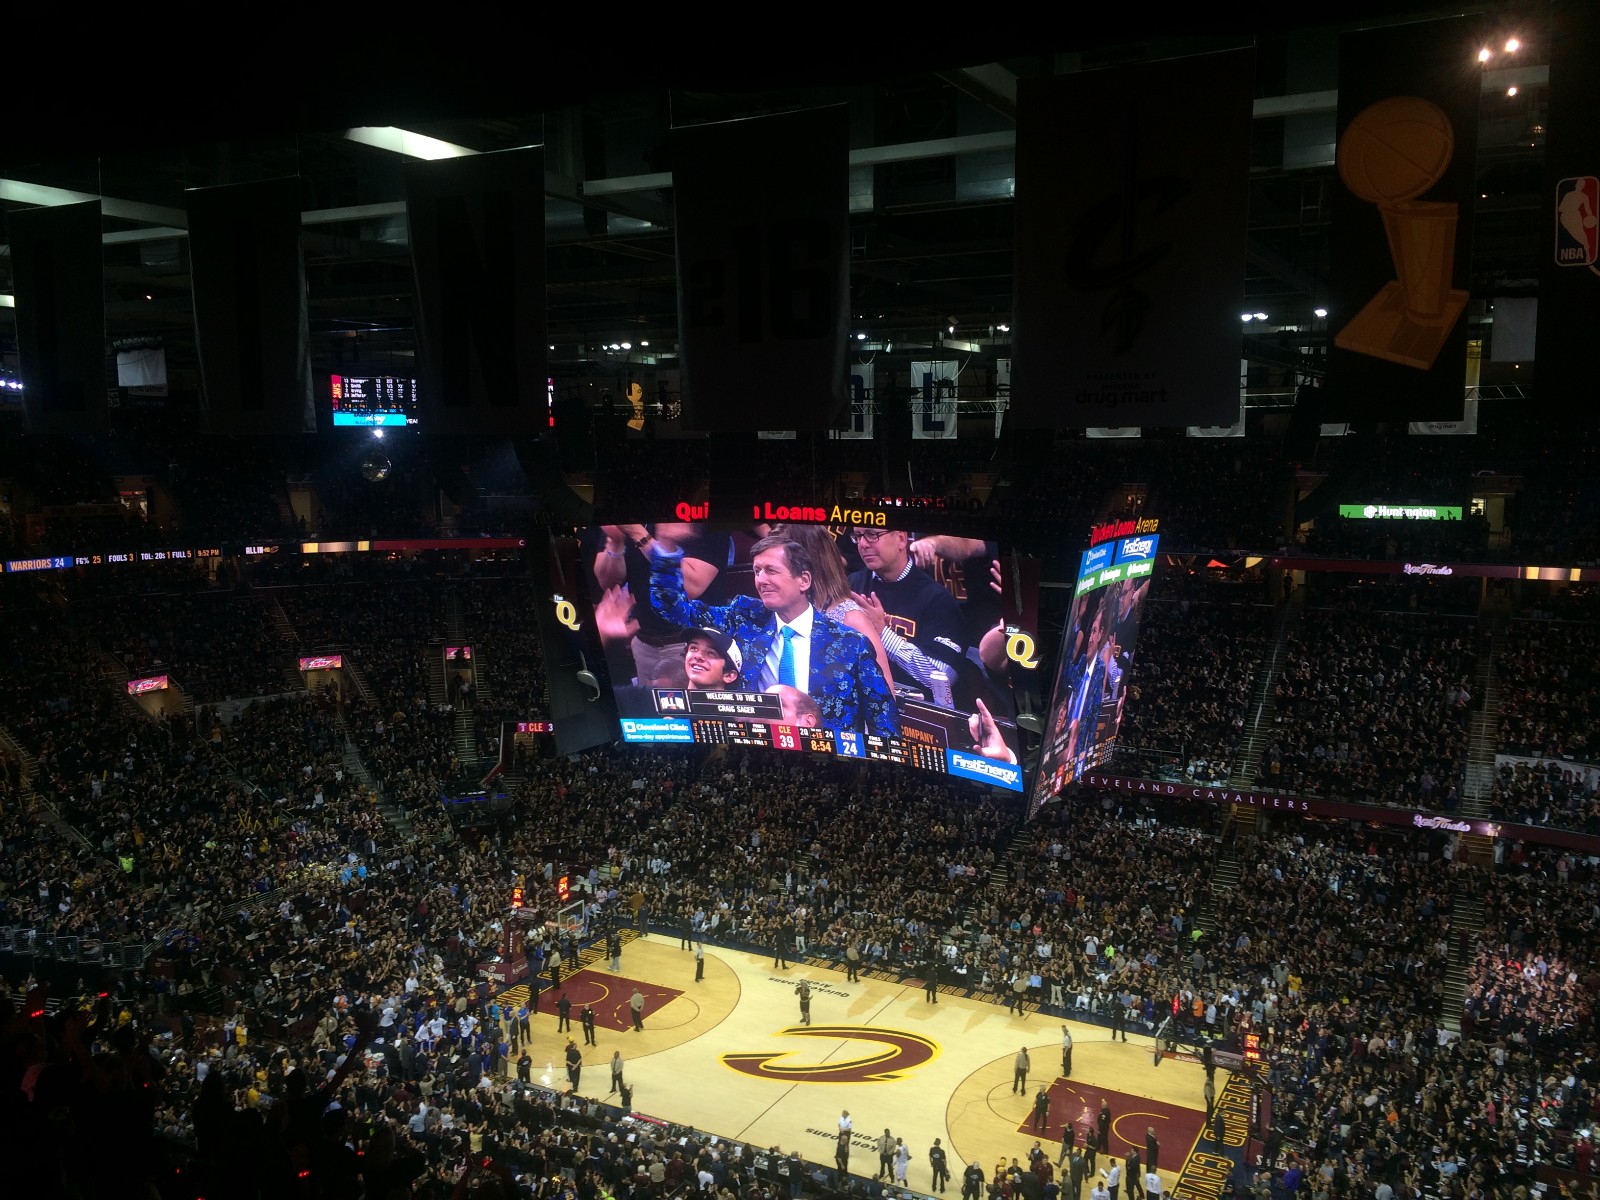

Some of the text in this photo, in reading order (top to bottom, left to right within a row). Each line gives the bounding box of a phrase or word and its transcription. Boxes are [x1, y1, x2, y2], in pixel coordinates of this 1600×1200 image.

[1560, 248, 1584, 260] NBA
[1075, 388, 1168, 408] drug mart
[765, 502, 826, 522] Loans
[830, 505, 886, 526] Arena
[1378, 506, 1436, 520] Huntington
[1135, 517, 1158, 533] Arena
[10, 559, 52, 571] WARRIORS
[54, 558, 65, 568] 24
[76, 556, 90, 565] FG%
[92, 555, 102, 564] 25
[108, 554, 128, 562] FOULS
[129, 553, 134, 562] 3
[1420, 564, 1452, 575] Finals
[554, 600, 580, 630] Q
[1006, 633, 1038, 669] Q
[706, 692, 734, 701] WELCOME
[718, 705, 756, 714] CRAIG SAGER
[529, 723, 543, 732] CLE
[636, 723, 689, 732] Cleveland Clinic
[778, 726, 791, 734] CLE
[779, 735, 794, 748] 39
[840, 732, 856, 741] GSW
[901, 726, 934, 744] OMPANY
[811, 740, 832, 752] 8:54
[843, 741, 857, 755] 24
[952, 754, 1018, 781] FirstEnergy
[1193, 789, 1308, 810] CAVALIERS
[1431, 816, 1470, 832] Finals
[866, 970, 900, 984] ONE
[805, 1128, 840, 1140] oans
